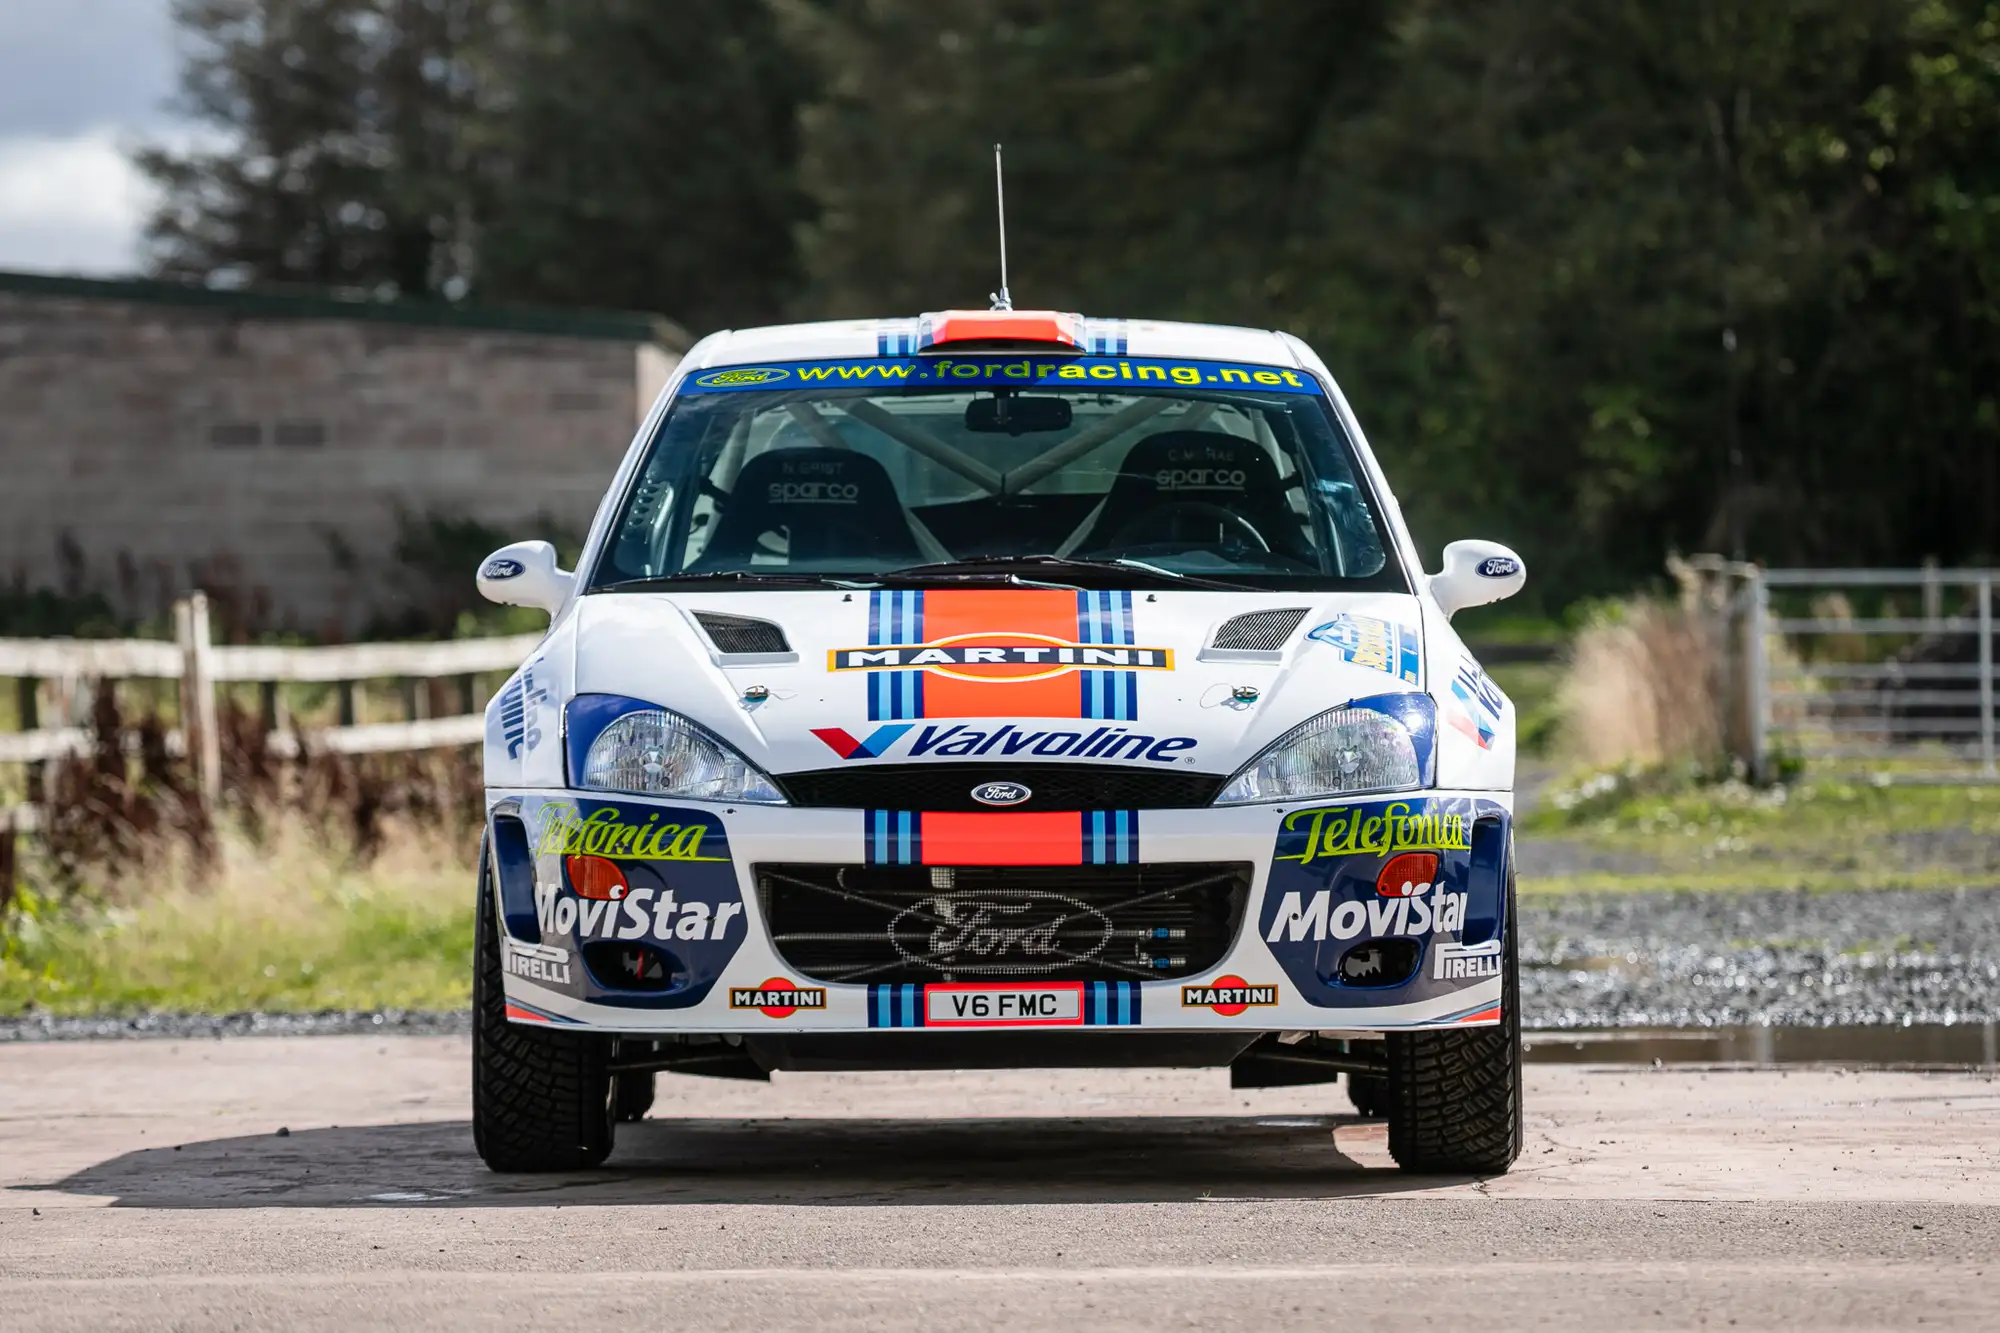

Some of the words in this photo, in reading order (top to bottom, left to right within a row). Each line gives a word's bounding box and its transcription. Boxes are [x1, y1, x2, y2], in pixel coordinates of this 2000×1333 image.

[711, 370, 770, 385] Ford
[796, 360, 1303, 387] www.fordracing.net
[1156, 469, 1246, 491] sparco
[768, 482, 859, 504] sparco
[485, 561, 515, 578] Ford
[1486, 558, 1515, 575] Ford
[847, 647, 1155, 667] MARTINI
[908, 725, 1198, 762] Valvoline
[982, 785, 1018, 801] Ford
[929, 900, 1067, 956] Ford
[502, 936, 571, 985] PIRELLI
[1433, 939, 1501, 980] PIRELLI
[734, 990, 823, 1006] MARTINI
[952, 994, 990, 1017] V6
[998, 993, 1058, 1017] FMC
[1187, 988, 1274, 1004] MARTINI
